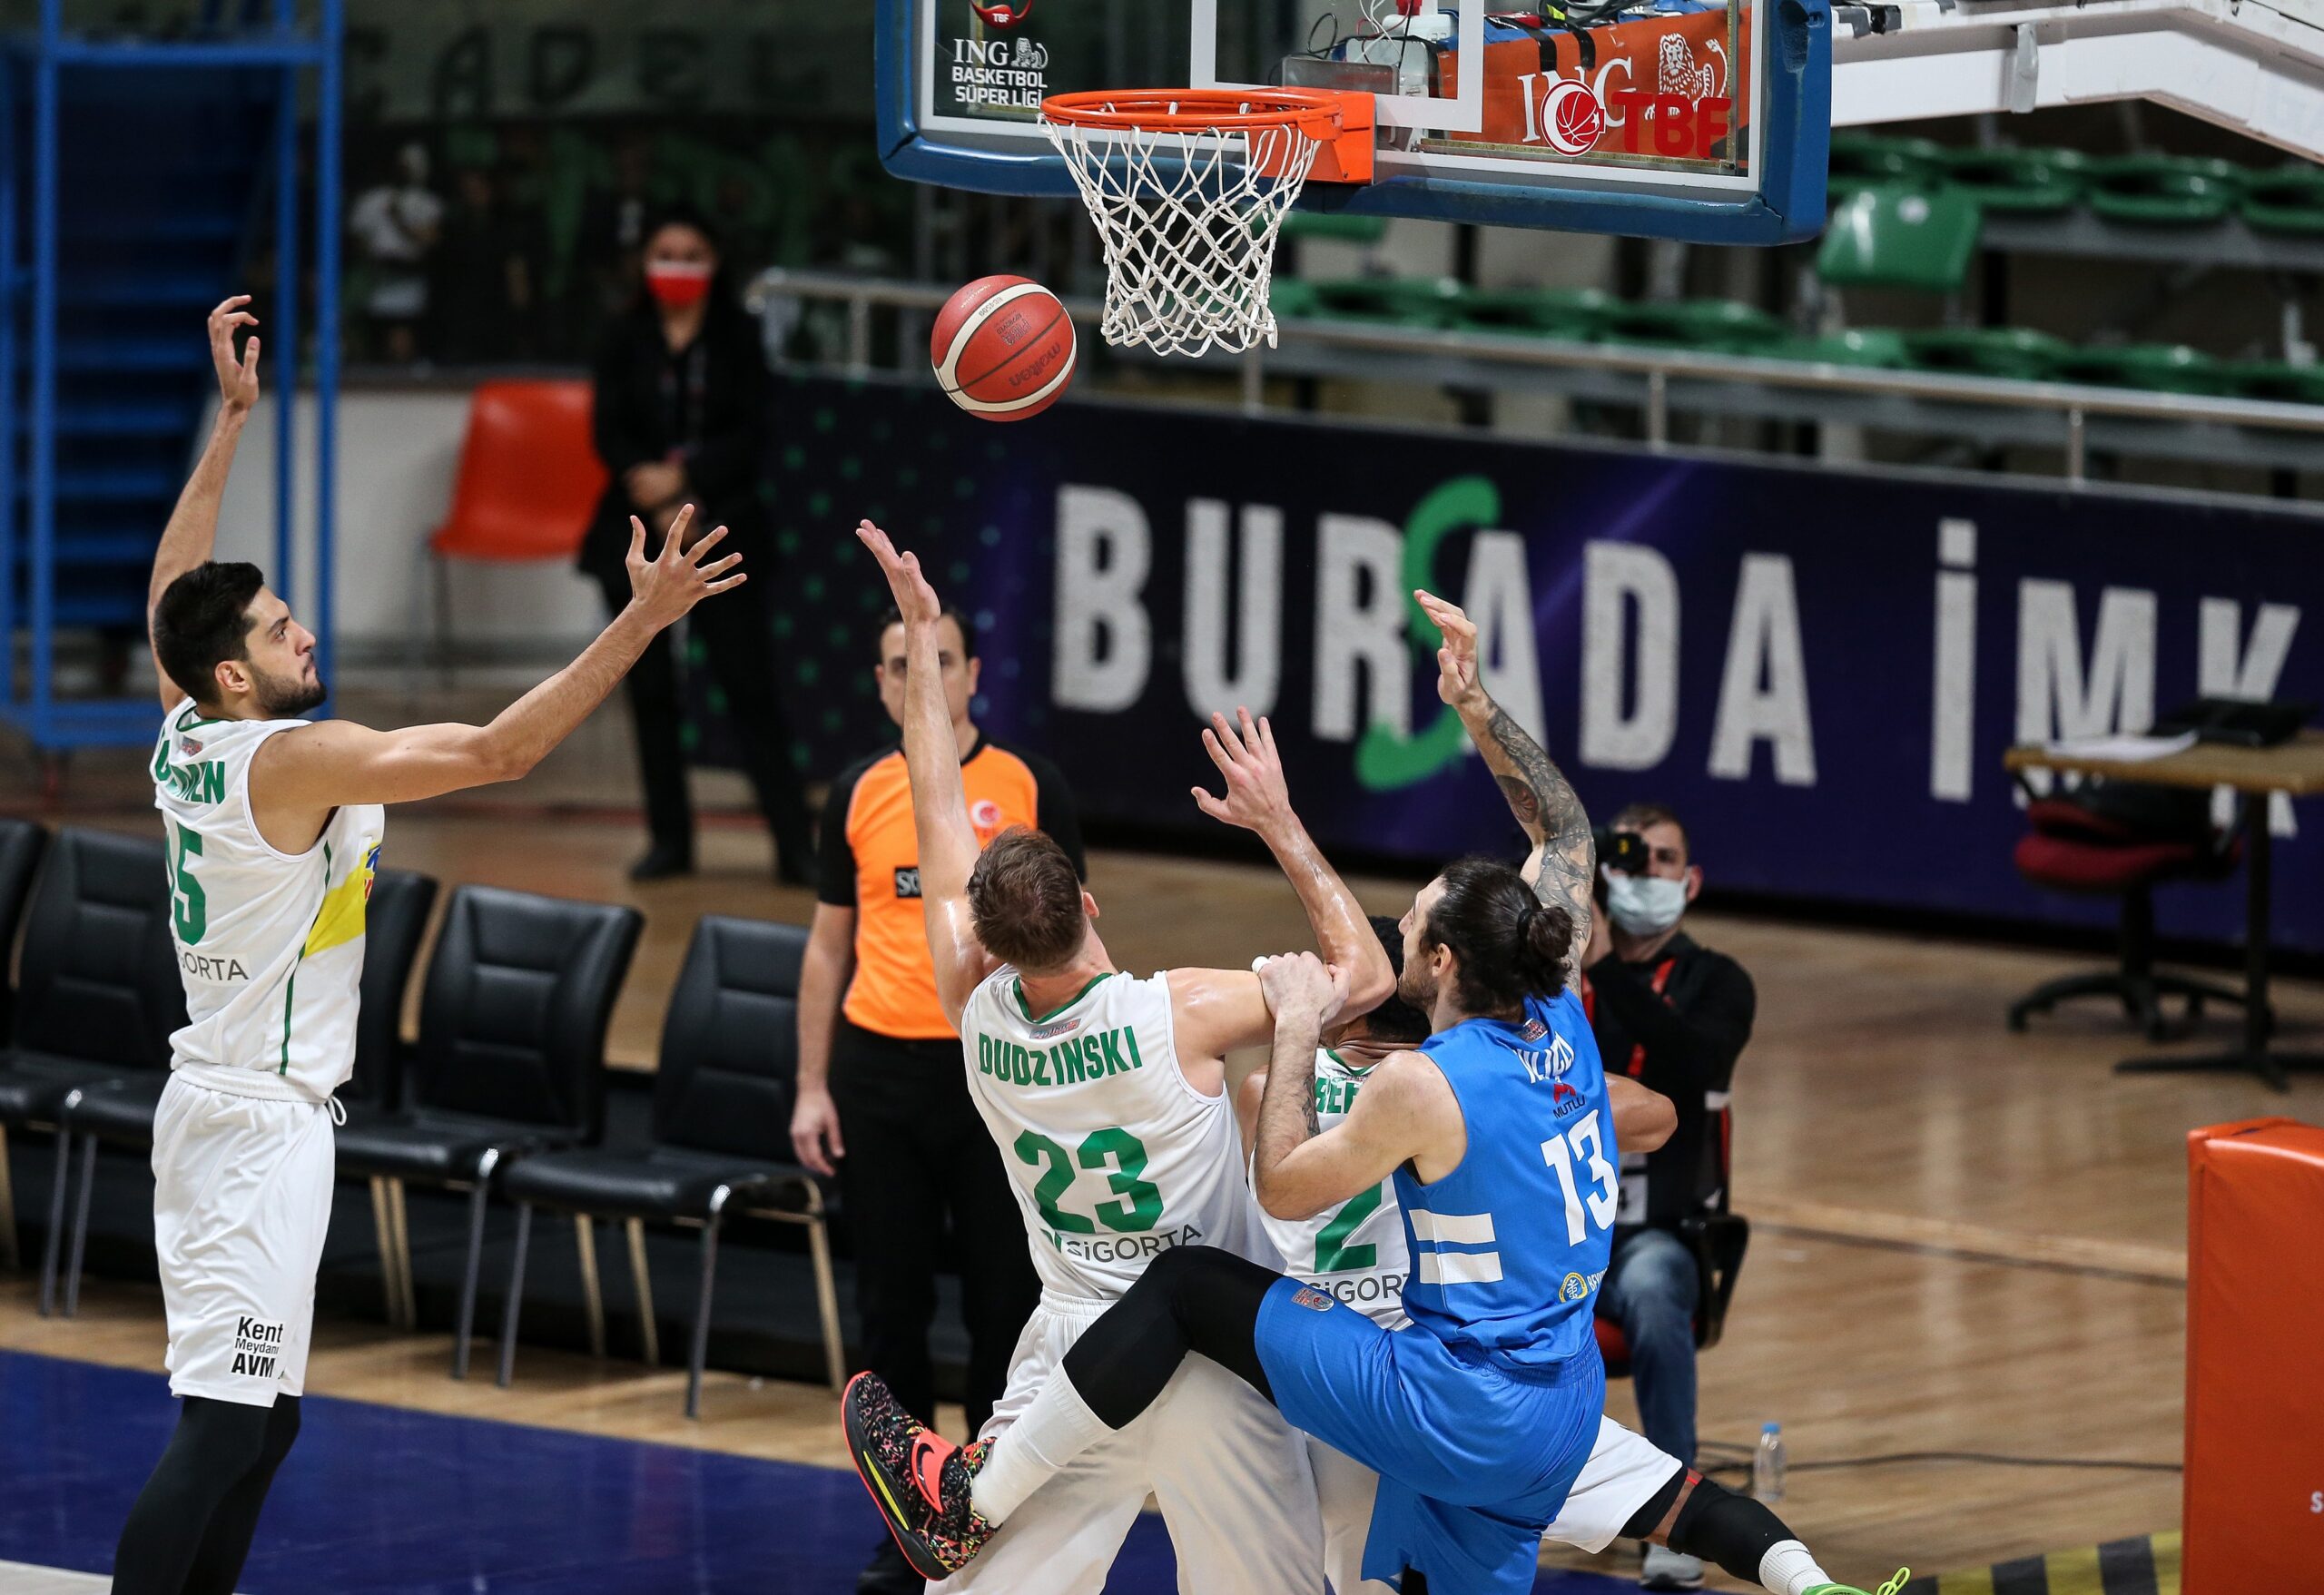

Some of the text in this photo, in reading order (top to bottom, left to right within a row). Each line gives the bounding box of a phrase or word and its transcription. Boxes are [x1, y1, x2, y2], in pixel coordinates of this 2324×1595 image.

[953, 38, 1009, 66] ING
[951, 65, 1048, 88] BASKETBOL
[955, 84, 1009, 106] SÜPER
[1610, 91, 1732, 158] TBF
[1009, 342, 1061, 387] molten
[165, 820, 207, 947] 5
[979, 1025, 1143, 1087] DUDZINSKI
[1553, 1095, 1586, 1118] MUTLU
[1013, 1127, 1165, 1235] 23
[1540, 1109, 1620, 1247] 13
[237, 1316, 283, 1343] Kent
[231, 1352, 276, 1378] AVM
